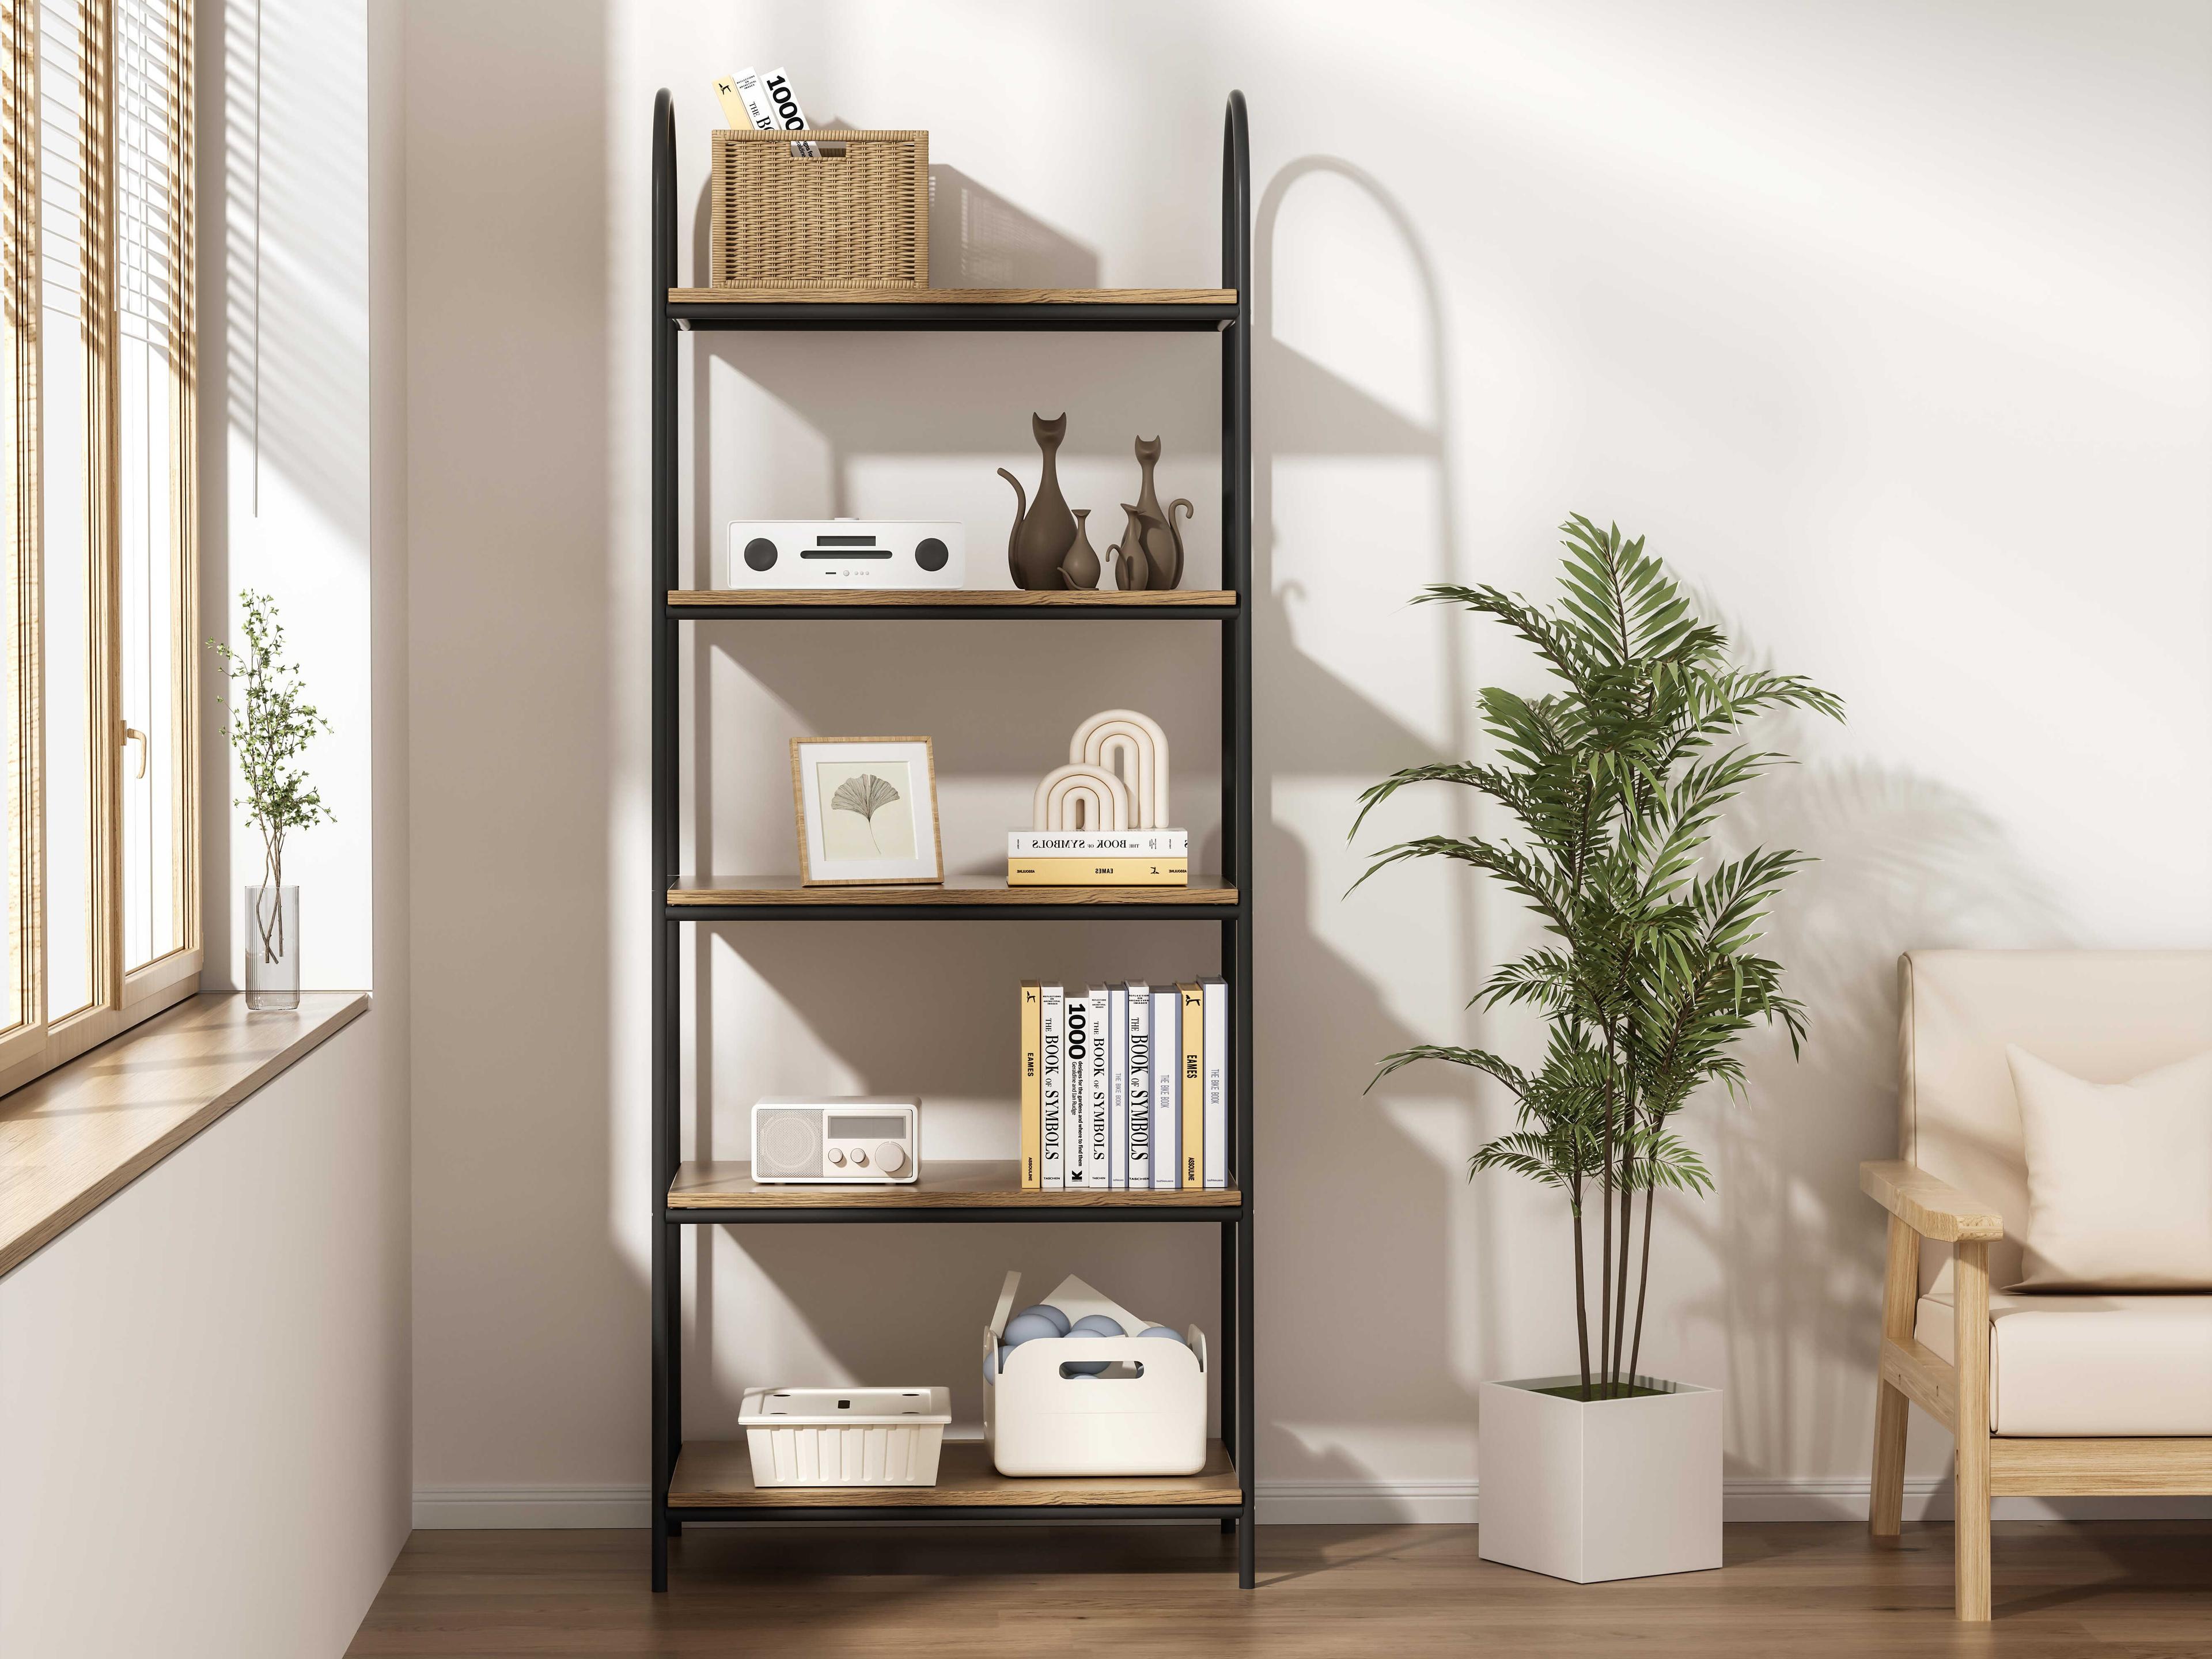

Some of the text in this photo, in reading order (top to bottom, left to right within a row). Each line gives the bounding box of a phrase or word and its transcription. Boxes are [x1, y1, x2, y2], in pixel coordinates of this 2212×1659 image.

[749, 101, 760, 117] THE
[767, 75, 804, 130] 1000
[1069, 1004, 1086, 1059] 1000
[1046, 1035, 1059, 1075] BOOK
[1094, 1038, 1104, 1077] BOOK
[1131, 1035, 1148, 1075] BOOK
[1187, 1055, 1197, 1078] EAMES
[1046, 1078, 1051, 1087] OF
[1094, 1080, 1099, 1088] OF
[1131, 1078, 1139, 1087] OF
[1161, 1075, 1169, 1108] THE BIKE BOOK
[1046, 1091, 1059, 1160] SYMBOLS
[1094, 1092, 1104, 1160] SYMBOLS
[1131, 1090, 1148, 1160] SYMBOLS
